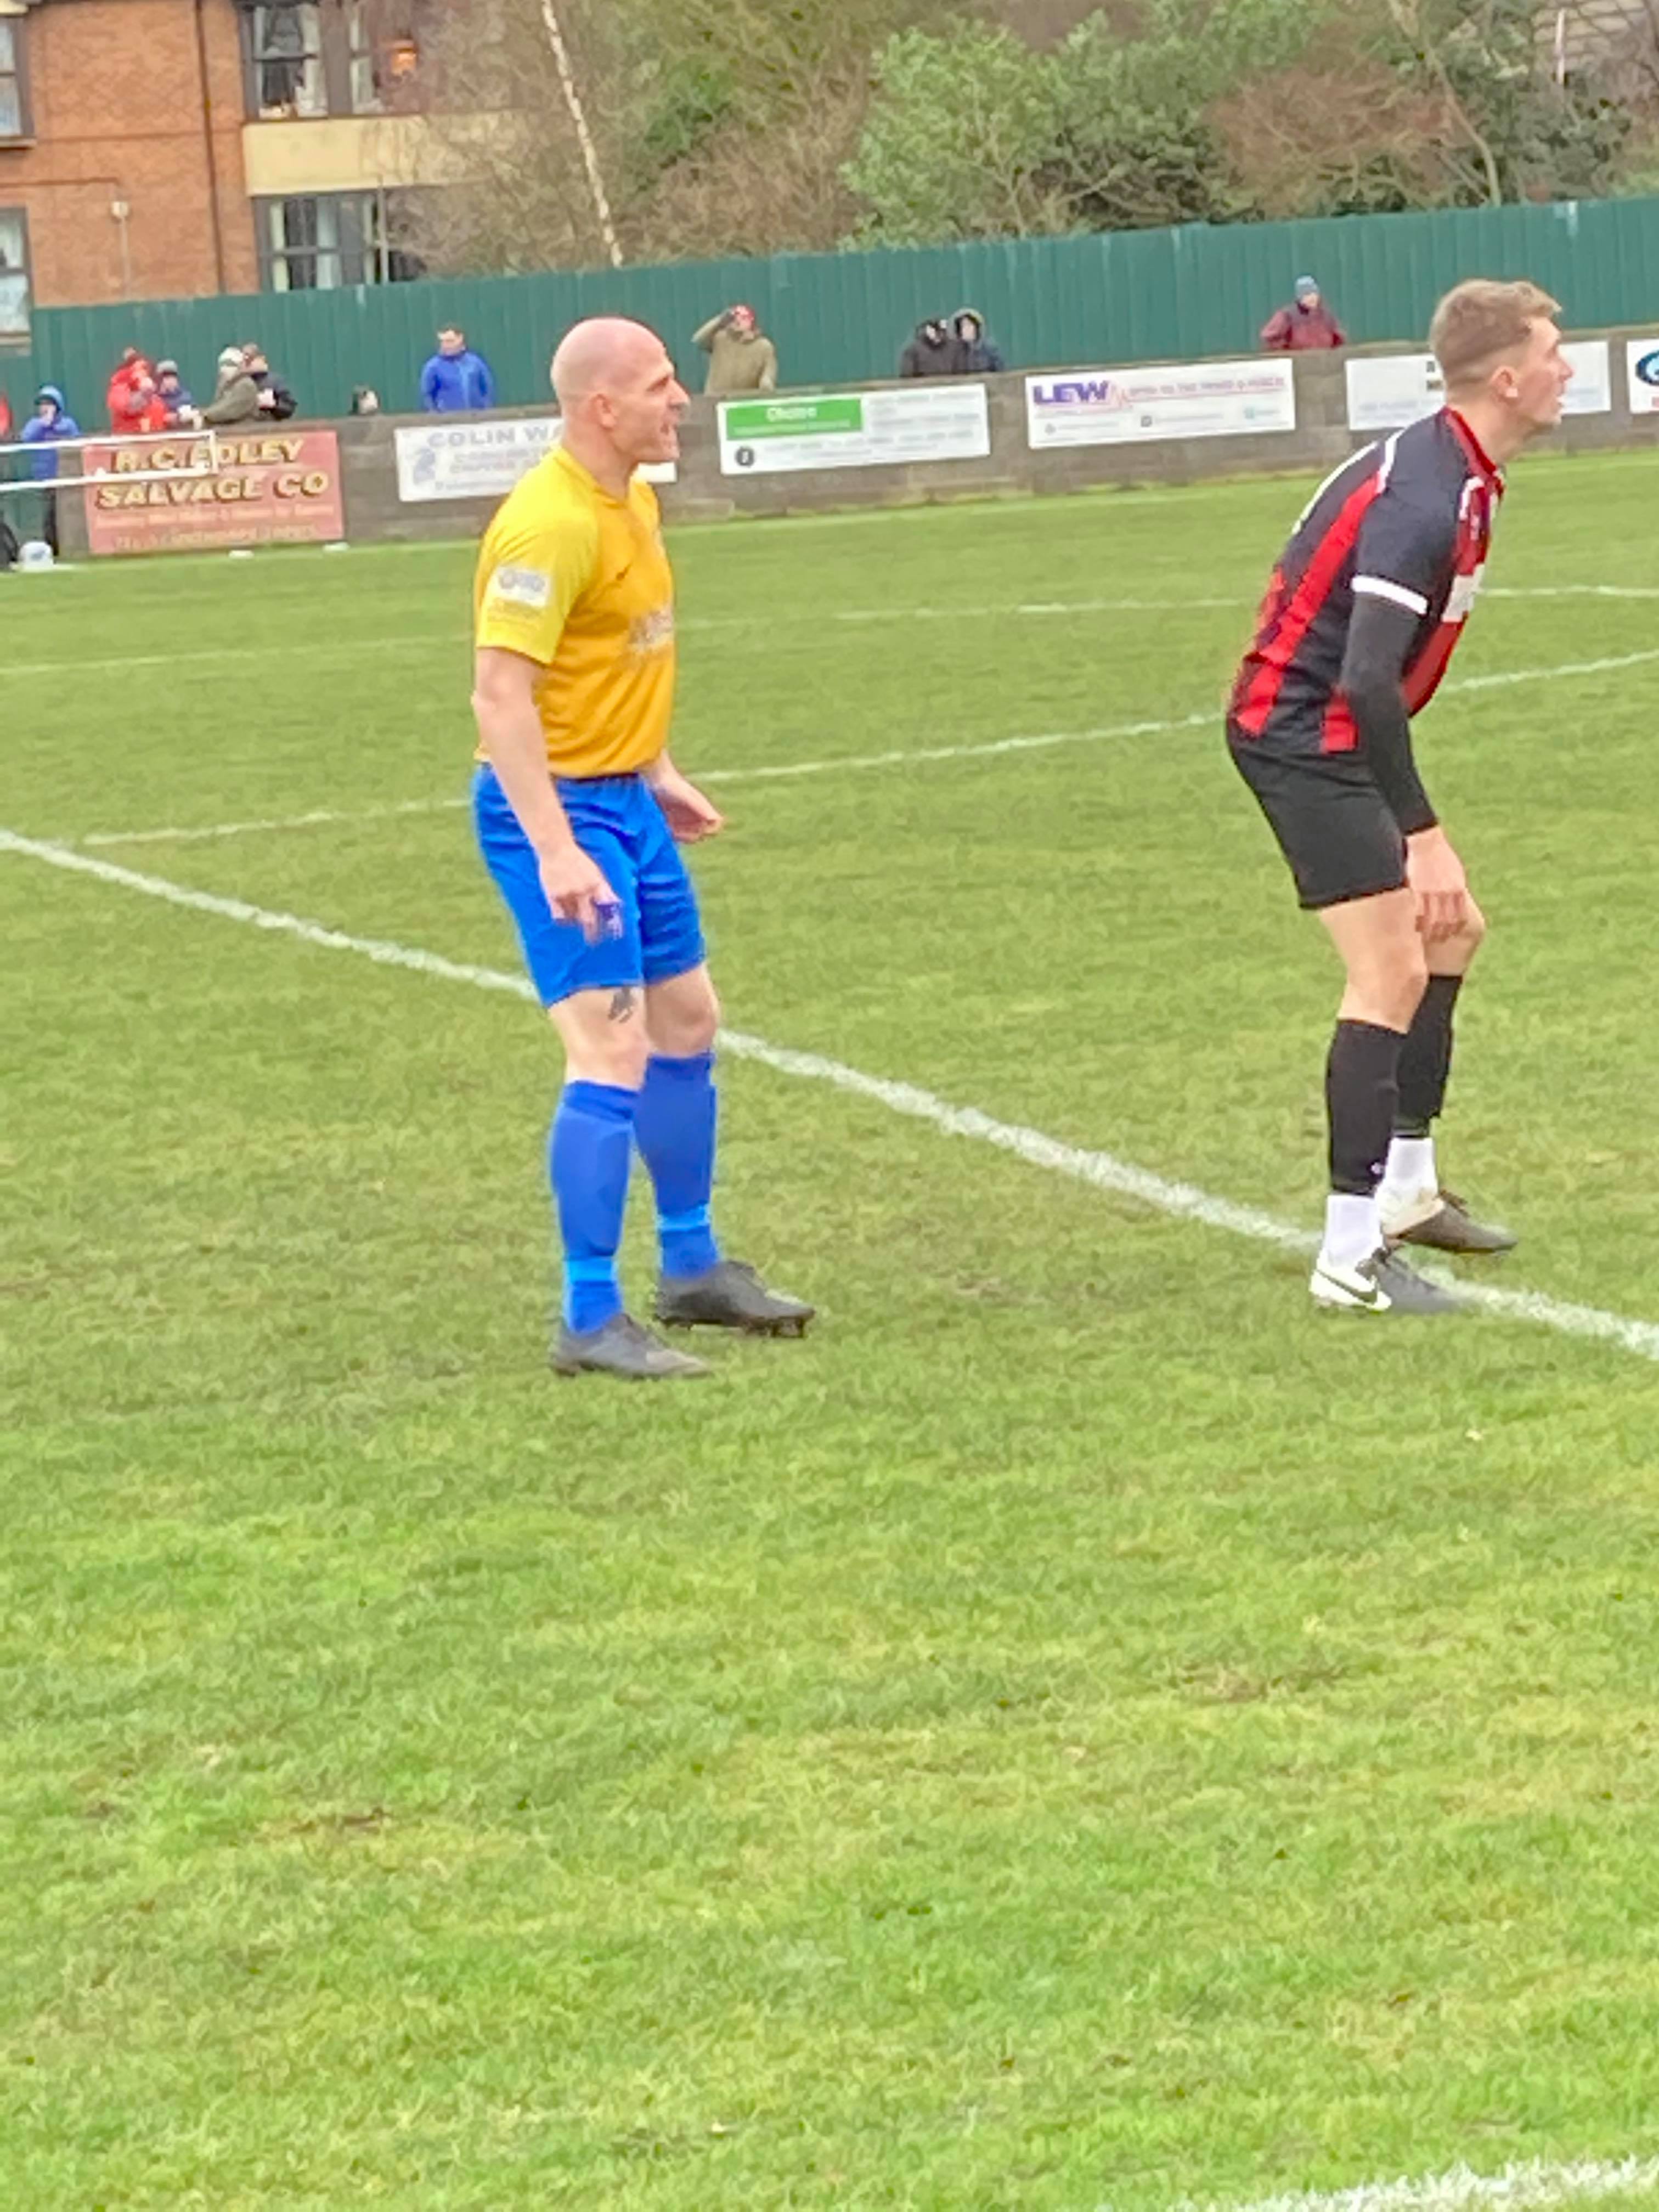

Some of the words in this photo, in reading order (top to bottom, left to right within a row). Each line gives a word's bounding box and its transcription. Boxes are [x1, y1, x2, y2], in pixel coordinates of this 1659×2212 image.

[1032, 380, 1109, 404] LEW
[427, 427, 516, 449] COLIN
[95, 474, 262, 509] SALVAGE
[274, 472, 329, 498] CO
